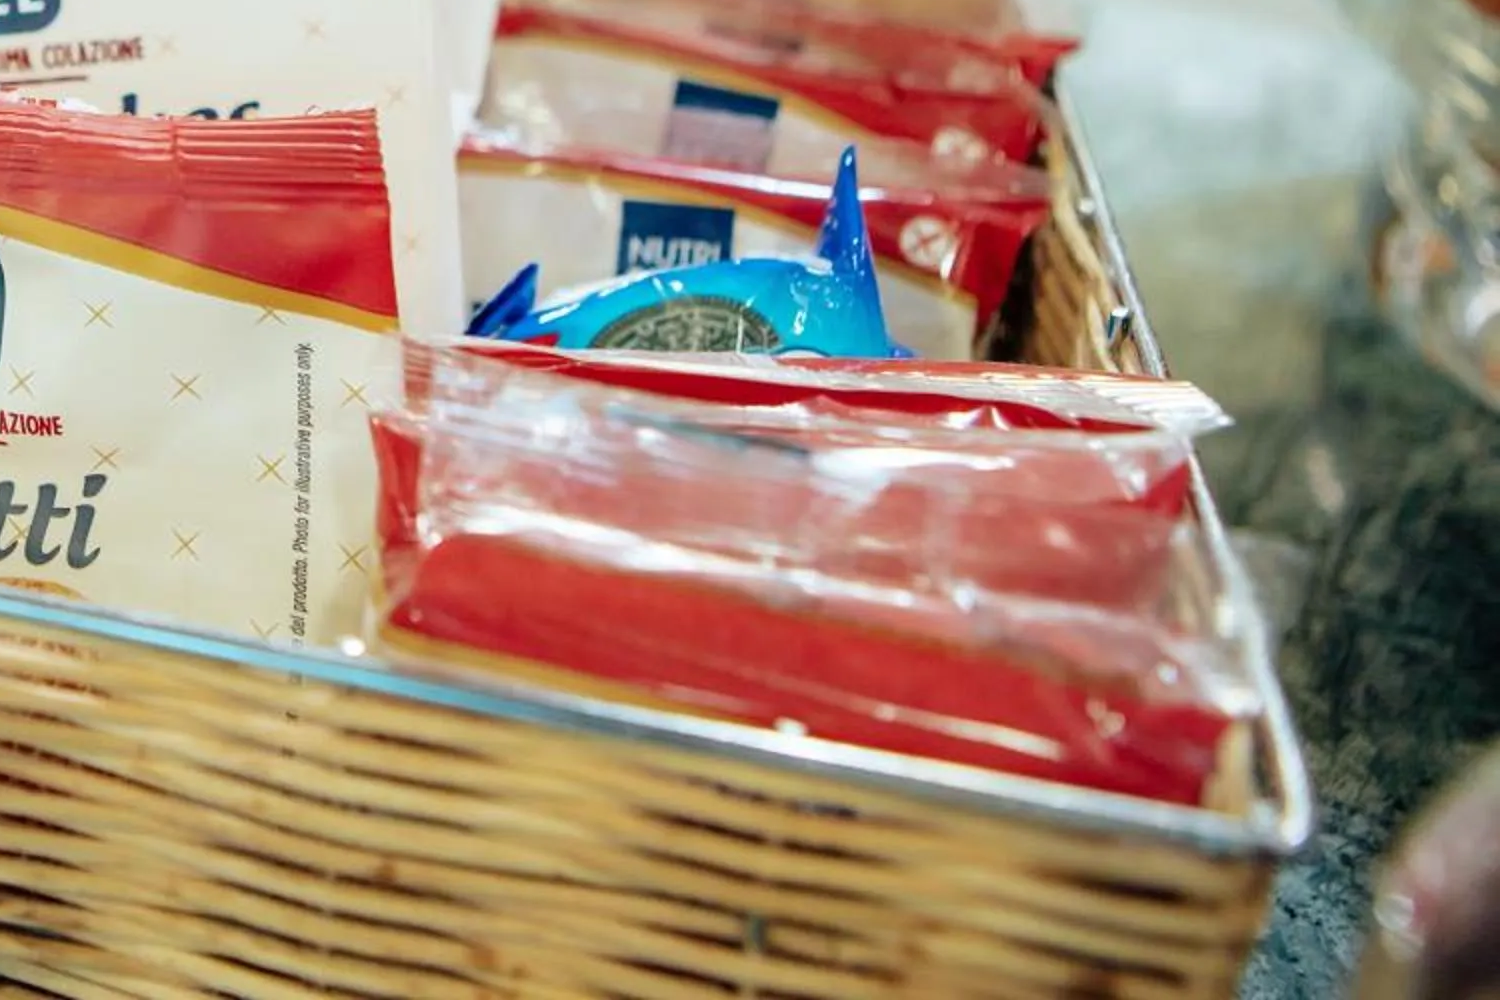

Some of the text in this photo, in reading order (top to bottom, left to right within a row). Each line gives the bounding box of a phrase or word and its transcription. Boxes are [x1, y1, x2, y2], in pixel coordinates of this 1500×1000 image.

[41, 36, 144, 70] COLAZIONE
[627, 235, 721, 266] NUTRI
[297, 373, 314, 428] purposes
[294, 430, 311, 493] illustrative
[294, 494, 311, 515] for
[292, 516, 309, 553] Photo
[289, 613, 306, 637] del
